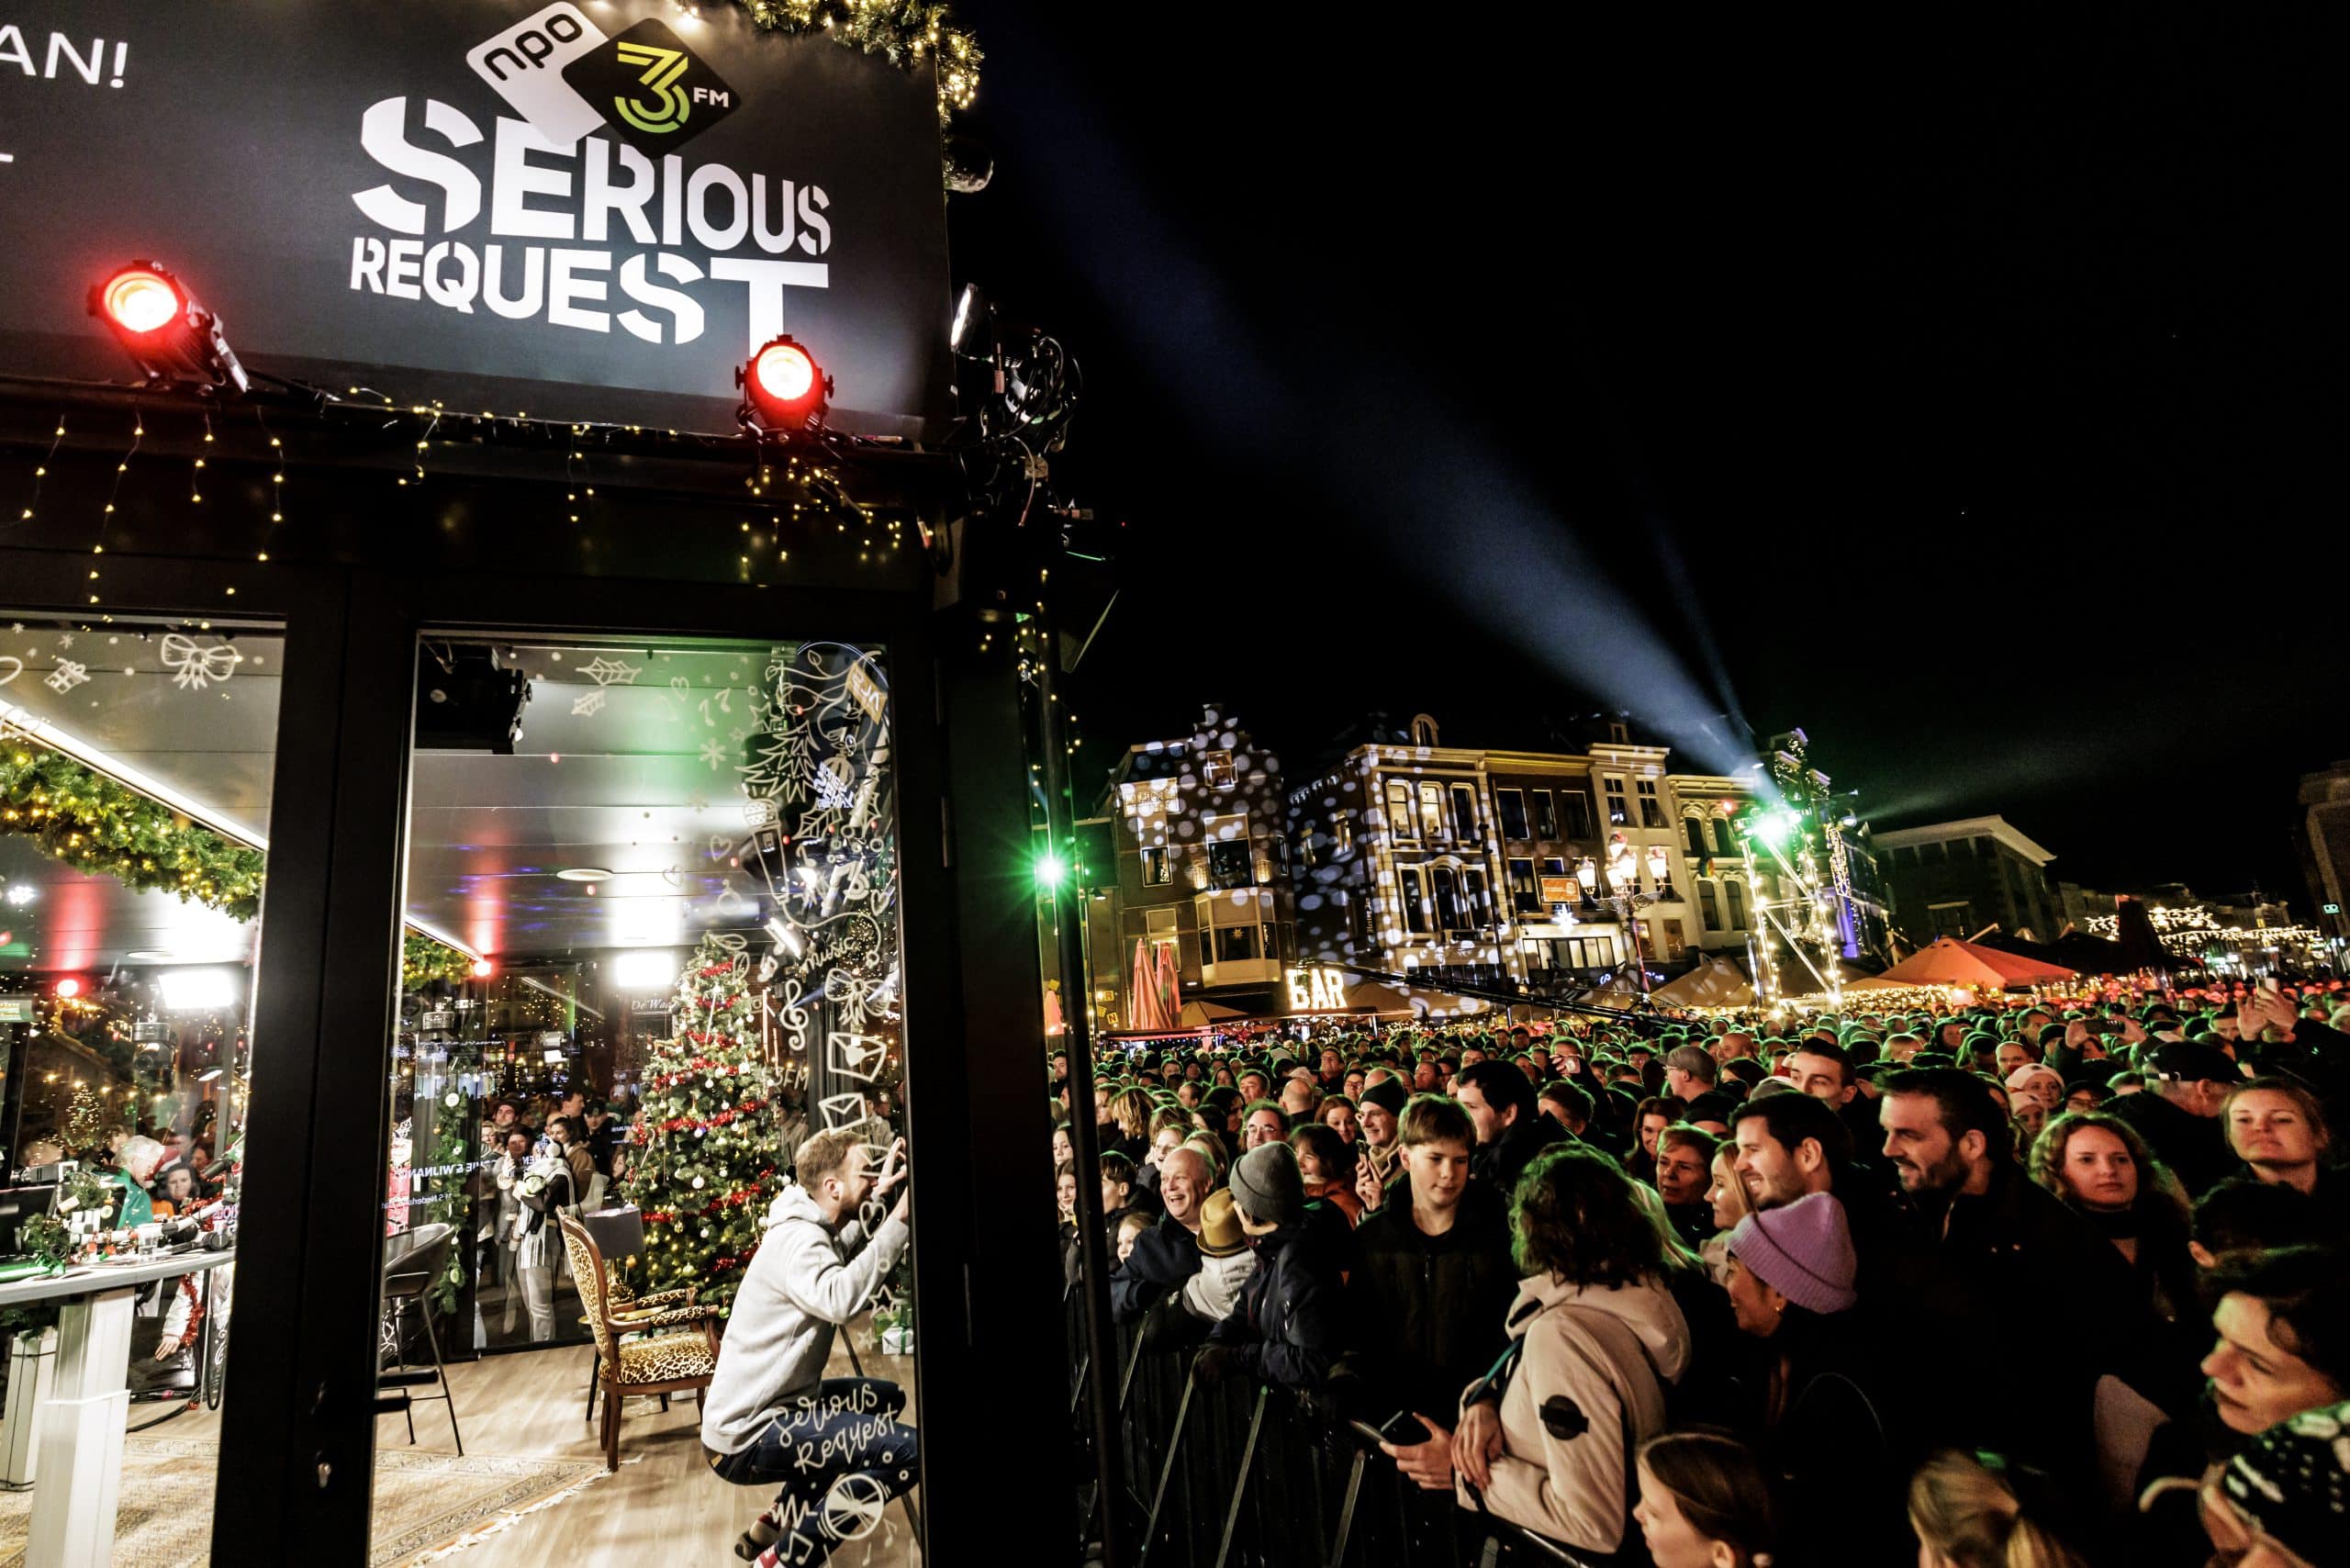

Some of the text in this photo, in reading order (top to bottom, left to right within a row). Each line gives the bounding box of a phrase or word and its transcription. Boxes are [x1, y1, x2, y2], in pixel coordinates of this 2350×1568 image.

[483, 13, 583, 82] npo
[351, 95, 832, 257] SERIOUS
[350, 235, 830, 359] REQUEST
[1285, 969, 1348, 1010] BAR
[773, 1383, 878, 1448] Serious
[793, 1402, 899, 1475] Request
